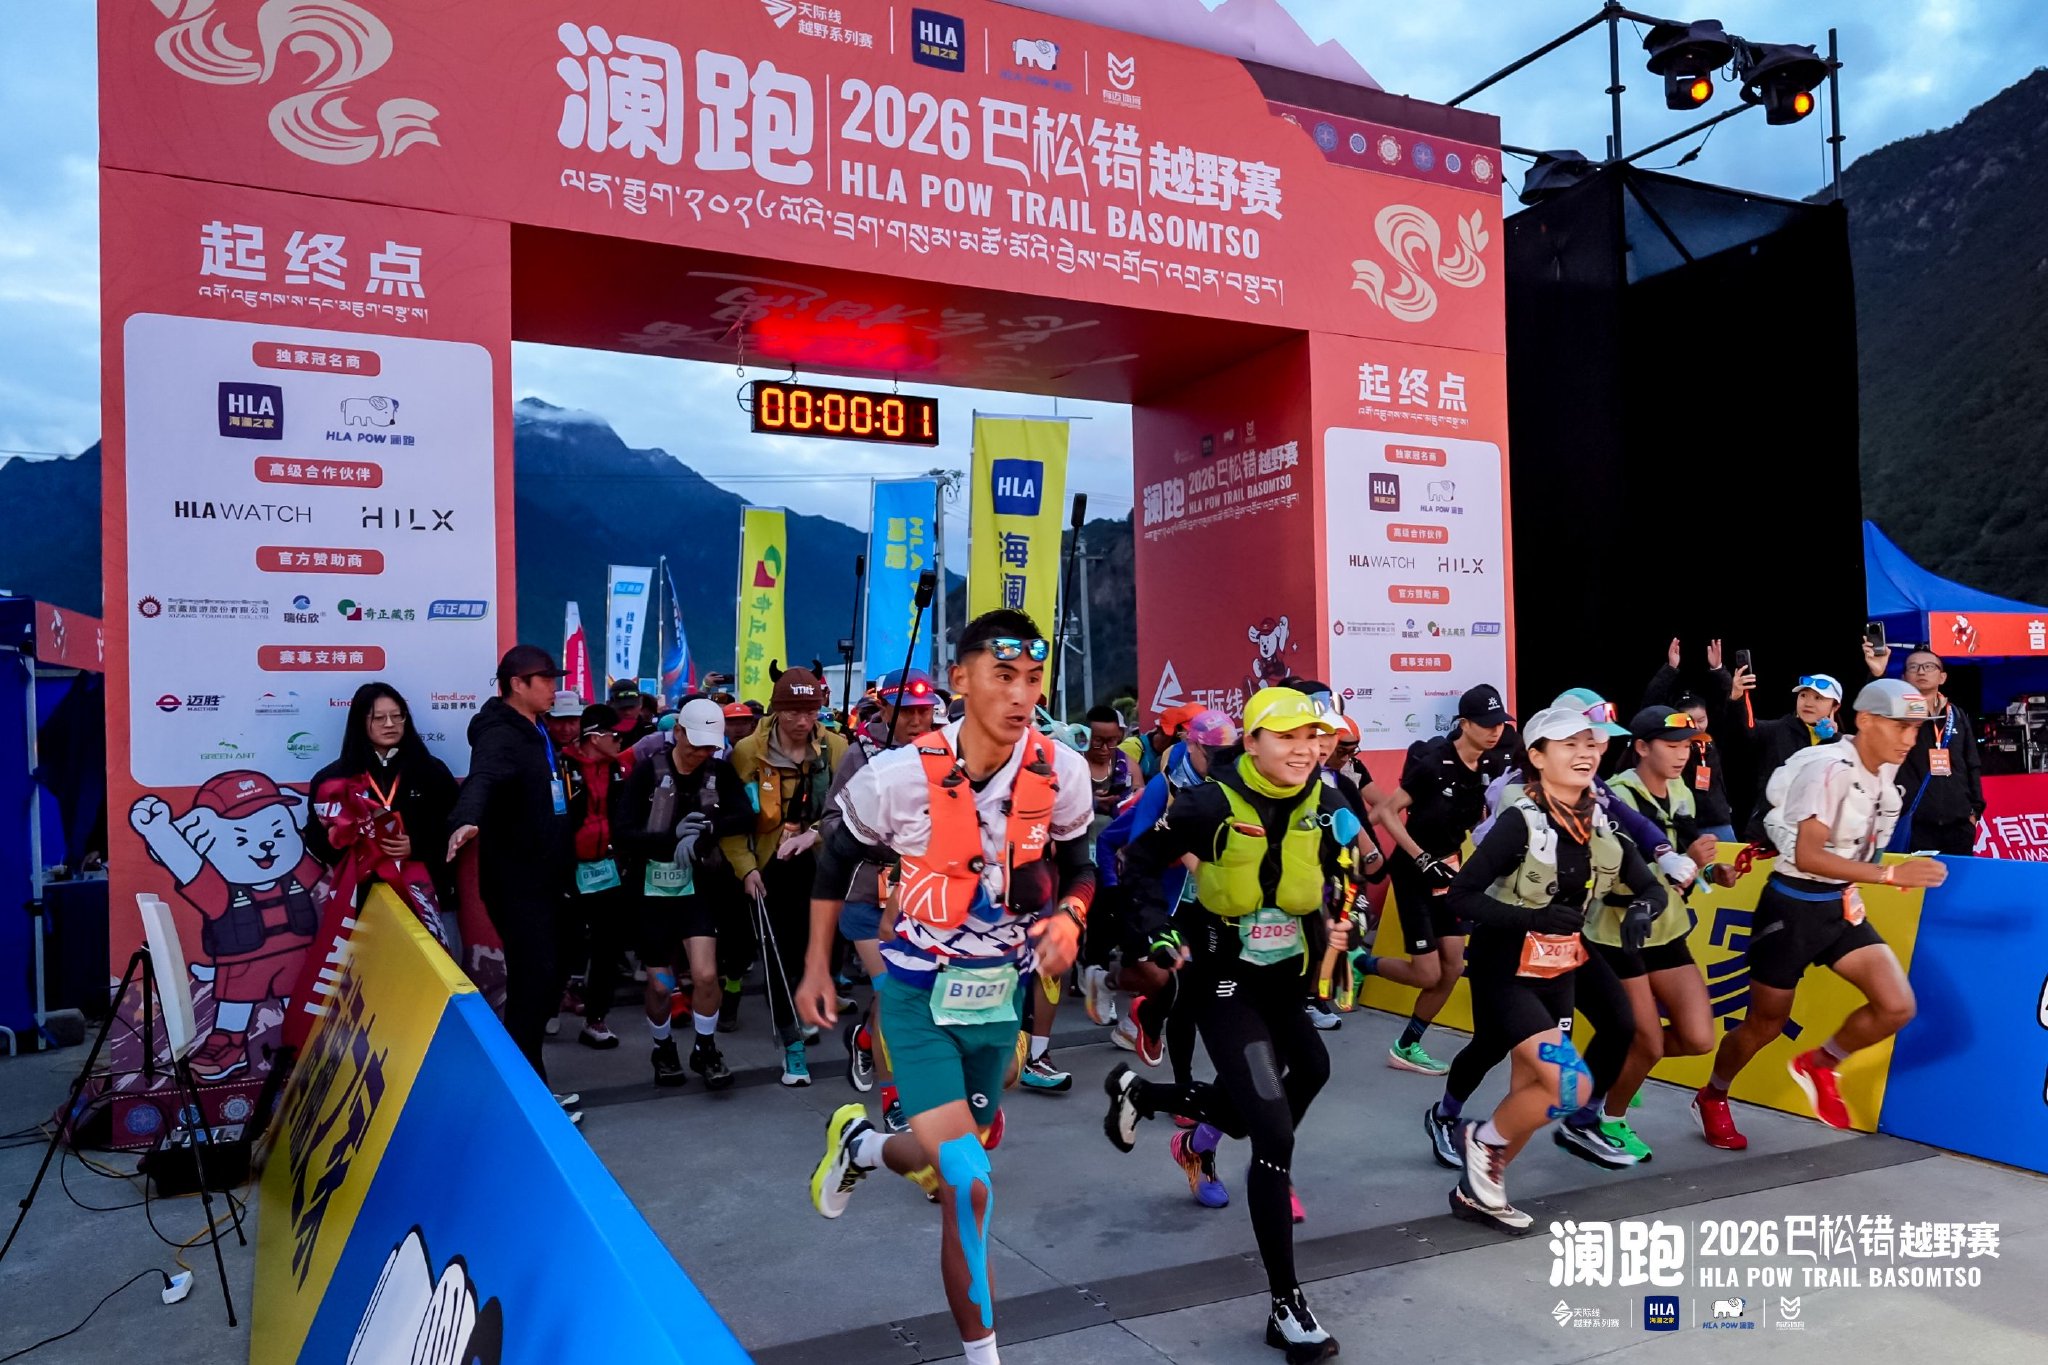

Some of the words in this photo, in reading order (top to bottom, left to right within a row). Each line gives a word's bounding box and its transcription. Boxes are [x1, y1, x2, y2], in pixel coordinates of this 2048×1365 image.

[798, 2, 842, 25] 天际线
[798, 19, 873, 49] 越野系列赛
[920, 20, 958, 48] HLA
[557, 22, 814, 186] 澜跑
[841, 159, 908, 204] HLA
[920, 173, 994, 218] POW
[1006, 188, 1097, 235] TRAIL
[1107, 205, 1261, 260] BASOMTSO
[199, 220, 427, 299] 起终点
[276, 347, 361, 369] 独家冠名商
[1358, 362, 1468, 412] 起终点
[228, 392, 275, 416] HLA
[761, 387, 931, 437] 00:00:01
[228, 415, 275, 429] 海澜之家
[325, 430, 352, 443] HLA
[357, 432, 387, 444] POW
[269, 462, 372, 482] 高级合作伙伴
[997, 476, 1035, 498] HLA
[1188, 500, 1203, 515] HLA
[1204, 494, 1221, 511] POW
[1223, 488, 1245, 506] TRAIL
[1247, 473, 1292, 499] BASOMTSO
[1373, 480, 1396, 496] HLA
[1143, 477, 1185, 527] 澜跑
[1435, 505, 1450, 513] POW
[361, 506, 456, 532] HILX
[1393, 527, 1443, 540] 高级合作伙伴
[277, 551, 363, 568] 官方赞助商
[1438, 556, 1484, 574] HILX
[283, 612, 320, 624] 瑞佑欣
[364, 608, 416, 621] 奇正藏药
[2028, 619, 2047, 650] 音
[279, 650, 364, 665] 赛事支持商
[186, 694, 221, 707] 迈胜
[430, 692, 477, 702] HandLove
[431, 702, 477, 710] 运动营养包
[1992, 812, 2048, 848] 有迈
[948, 982, 1006, 998] B1021
